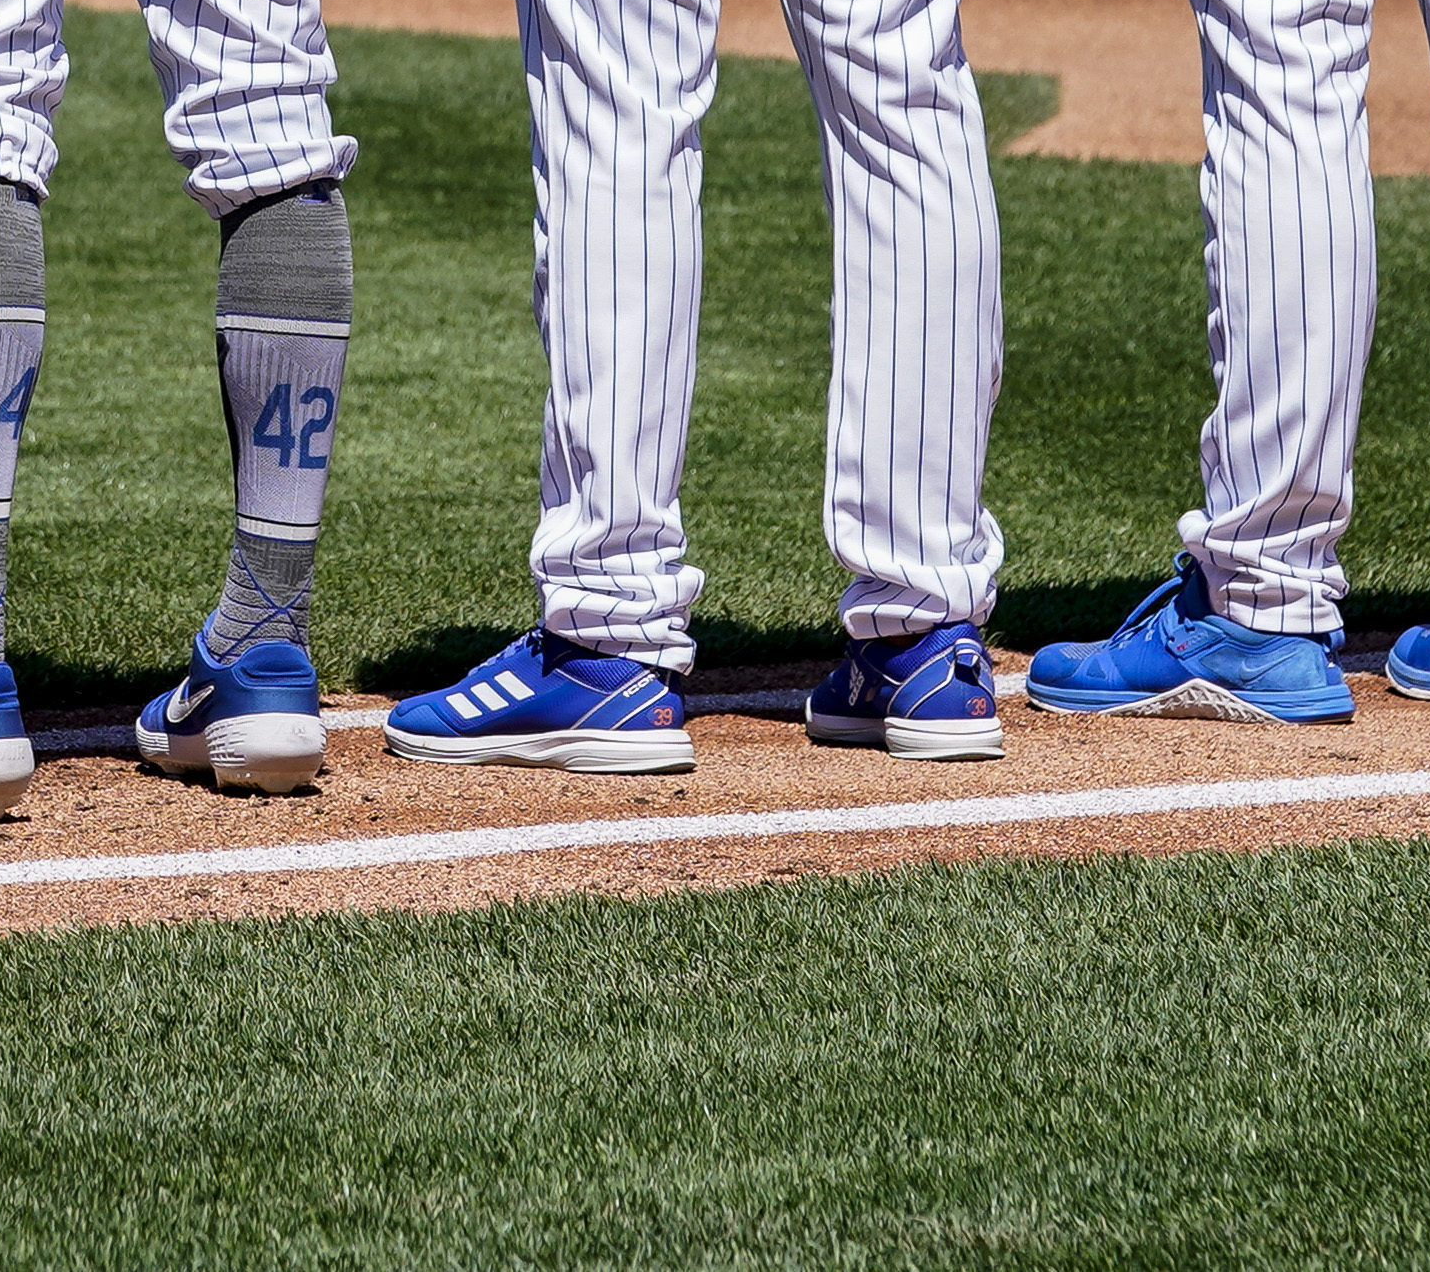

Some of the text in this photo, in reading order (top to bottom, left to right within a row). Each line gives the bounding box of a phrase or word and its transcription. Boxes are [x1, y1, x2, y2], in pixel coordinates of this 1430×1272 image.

[253, 384, 335, 469] 42
[970, 696, 987, 716] 39
[652, 707, 674, 726] 39
